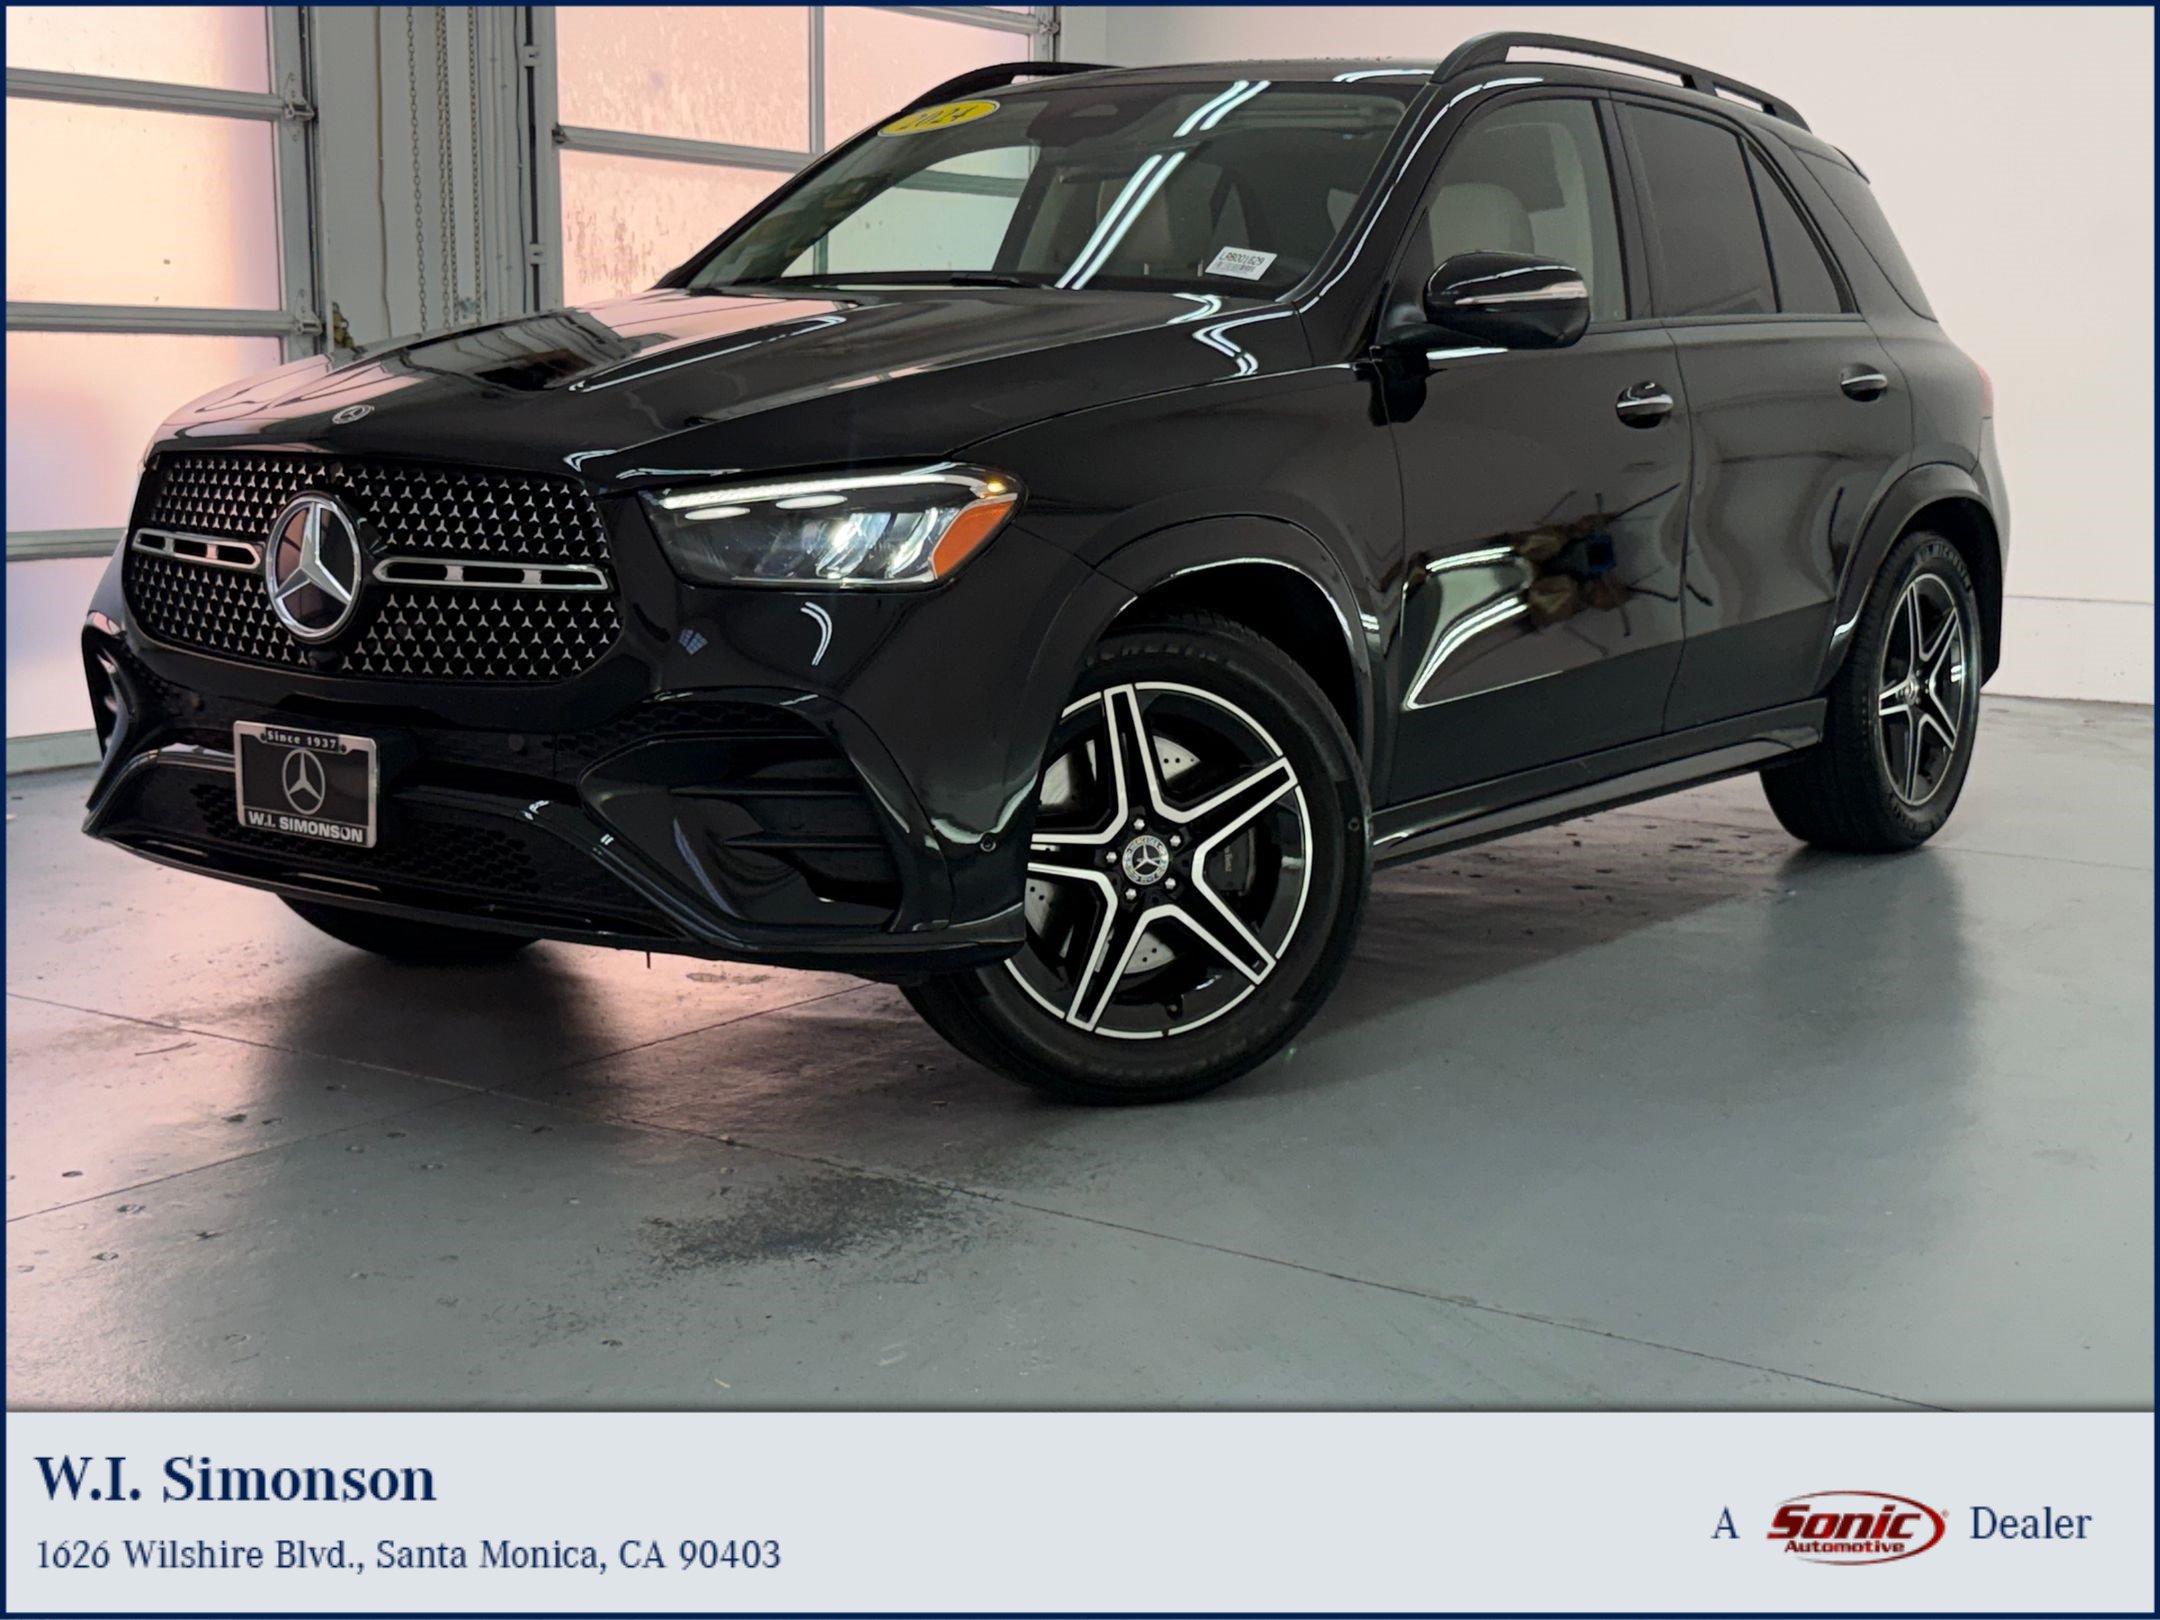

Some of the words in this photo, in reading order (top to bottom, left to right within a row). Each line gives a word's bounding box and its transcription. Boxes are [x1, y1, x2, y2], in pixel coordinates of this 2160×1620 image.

[267, 730, 301, 744] Since
[306, 735, 337, 749] 1937
[248, 810, 276, 827] W.I.
[279, 816, 364, 842] SIMONSON
